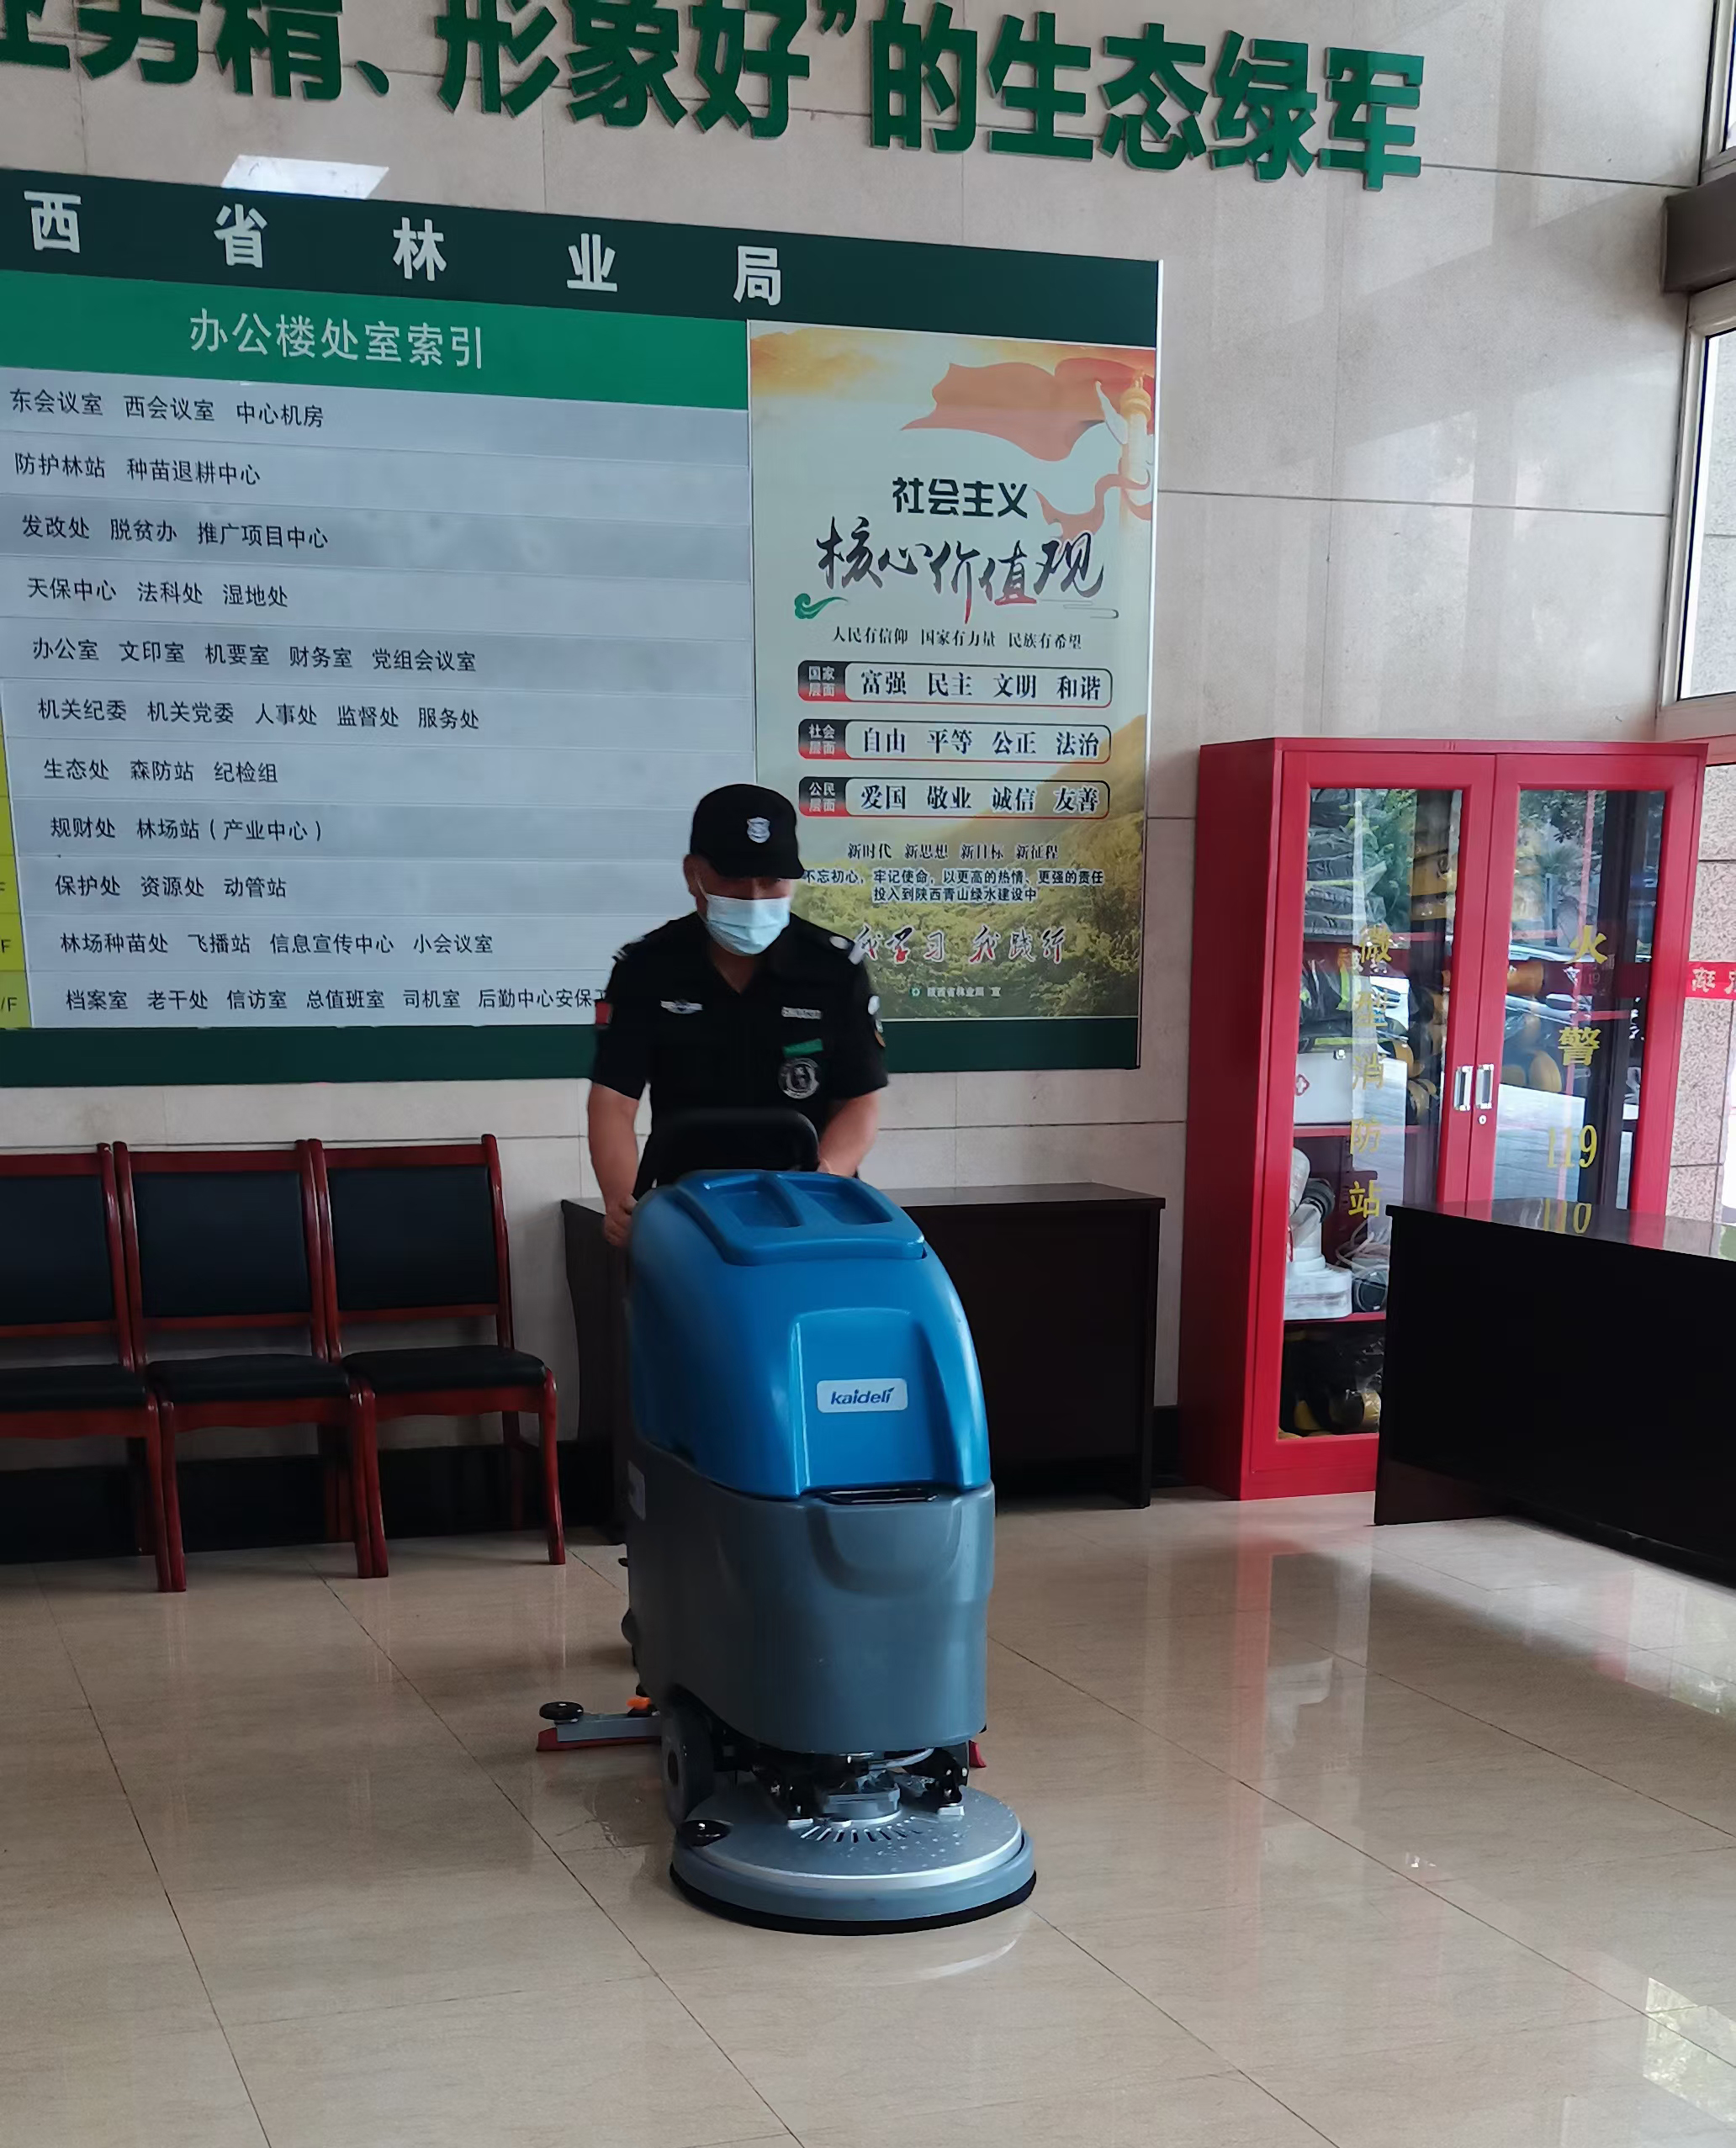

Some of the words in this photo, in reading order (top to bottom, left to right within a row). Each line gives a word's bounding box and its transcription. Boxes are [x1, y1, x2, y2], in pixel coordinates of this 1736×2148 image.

[189, 308, 484, 370] 办公楼处室索引
[9, 388, 103, 415] 东会议室
[123, 395, 214, 421] 西会议室
[236, 400, 324, 428] 中心机房
[14, 452, 105, 479] 防护林站
[126, 458, 261, 485] 种苗退耕中心
[892, 476, 1028, 519] 社会主义
[22, 514, 90, 539] 发改处
[110, 518, 177, 542] 脱贫办
[198, 521, 329, 549] 推广项目中心
[816, 516, 1104, 624] 核心价值观
[28, 578, 117, 601] 天保中心
[137, 581, 203, 605] 法科处
[222, 584, 288, 608] 湿地处
[834, 626, 908, 645] 人民有信仰
[921, 628, 996, 647] 国家有力量
[1008, 631, 1083, 650] 民族有希望
[33, 637, 99, 660] 办公室
[119, 640, 185, 664] 文印室
[204, 643, 270, 665] 机要室
[289, 646, 352, 669] 财务室
[372, 648, 476, 672] 党组会议室
[808, 665, 835, 681] 国家
[860, 669, 907, 696] 富强
[928, 671, 972, 697] 民主
[992, 673, 1037, 699] 文明
[1056, 675, 1101, 701] 和谐
[808, 682, 835, 697] 层面
[37, 698, 127, 722] 机关纪委
[147, 701, 234, 724] 机关党委
[255, 702, 317, 726] 人事处
[336, 705, 399, 727] 监督处
[418, 707, 479, 730] 服务处
[809, 722, 835, 739] 社会
[864, 727, 906, 754] 自由
[927, 728, 972, 754] 平等
[992, 731, 1036, 754] 公正
[1056, 731, 1099, 757] 法治
[809, 740, 835, 755] 层面
[44, 758, 109, 780] 生态处
[130, 759, 194, 781] 森防站
[214, 761, 278, 783] 纪检组
[808, 781, 836, 796] 公民
[860, 785, 906, 810] 爱国
[927, 785, 972, 810] 敬业
[992, 786, 1035, 812] 诚信
[1054, 786, 1099, 813] 友善
[809, 797, 836, 812] 层面
[50, 816, 116, 839] 规财处
[847, 844, 892, 860] 新时代
[904, 844, 948, 860] 新思想
[961, 844, 1003, 860] 新目标
[1016, 844, 1058, 860] 新征程
[55, 875, 121, 897] 保护处
[140, 876, 204, 897] 资源处
[224, 876, 287, 898] 动管站
[873, 887, 1037, 902] 投入到陕西青山绿水建设中
[60, 932, 168, 954] 林场种苗处
[187, 933, 251, 954] 飞播站
[269, 933, 394, 955] 信息宣传中心
[413, 933, 493, 955] 小会议室
[66, 989, 129, 1011] 档案室
[146, 989, 209, 1010] 老干处
[226, 988, 288, 1010] 信访室
[306, 989, 385, 1010] 总值班室
[403, 988, 461, 1008] 司机室
[1558, 924, 1608, 1066] 火警
[1547, 1124, 1598, 1168] 119
[830, 1387, 895, 1405] kaideli
